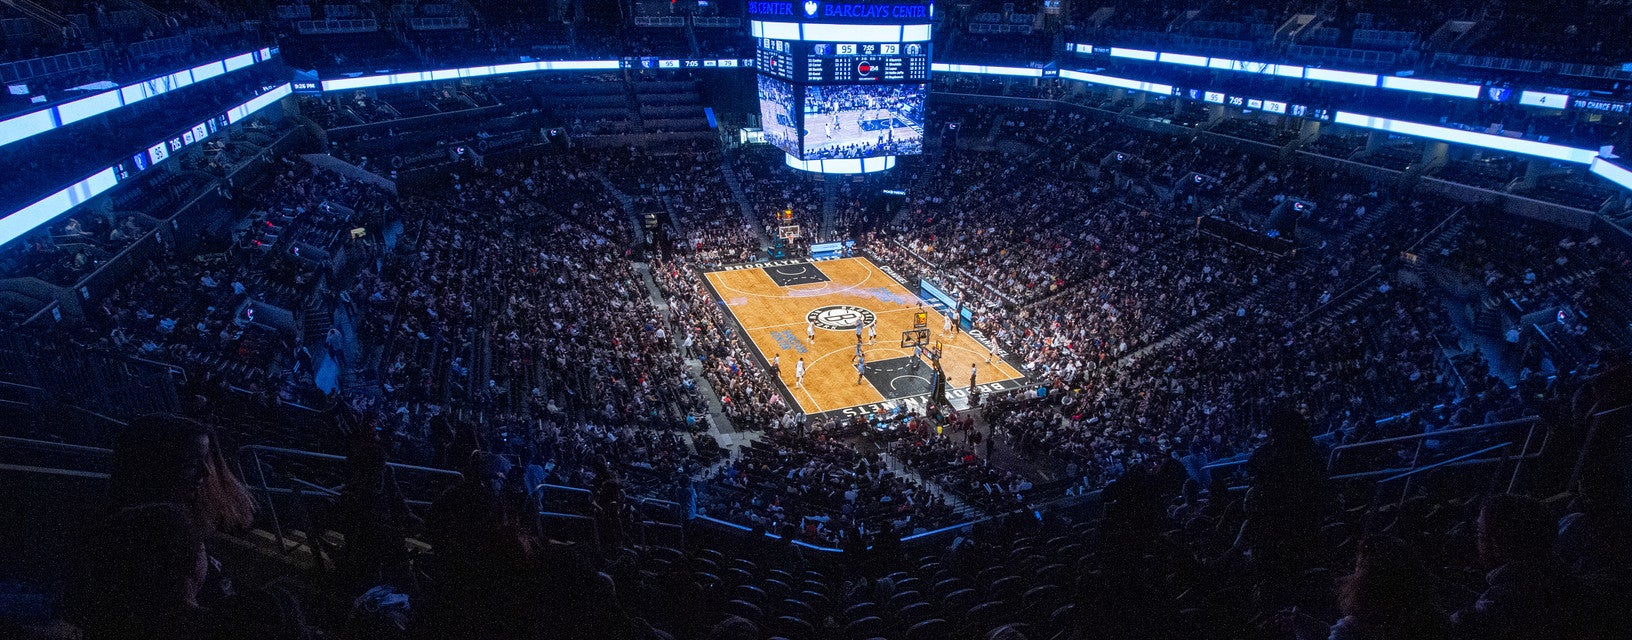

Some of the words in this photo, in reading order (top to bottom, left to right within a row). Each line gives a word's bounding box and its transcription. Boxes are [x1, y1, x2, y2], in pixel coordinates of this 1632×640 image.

[758, 2, 793, 15] CENTER
[824, 3, 889, 17] BARCLAYS
[892, 5, 926, 18] CENTER
[841, 45, 852, 54] 95
[885, 45, 896, 54] 79
[1229, 96, 1243, 106] 7:05
[1587, 101, 1611, 110] CHANCE
[1611, 102, 1624, 112] PTS
[169, 137, 182, 152] 7:05
[724, 260, 800, 271] BROOKLYN
